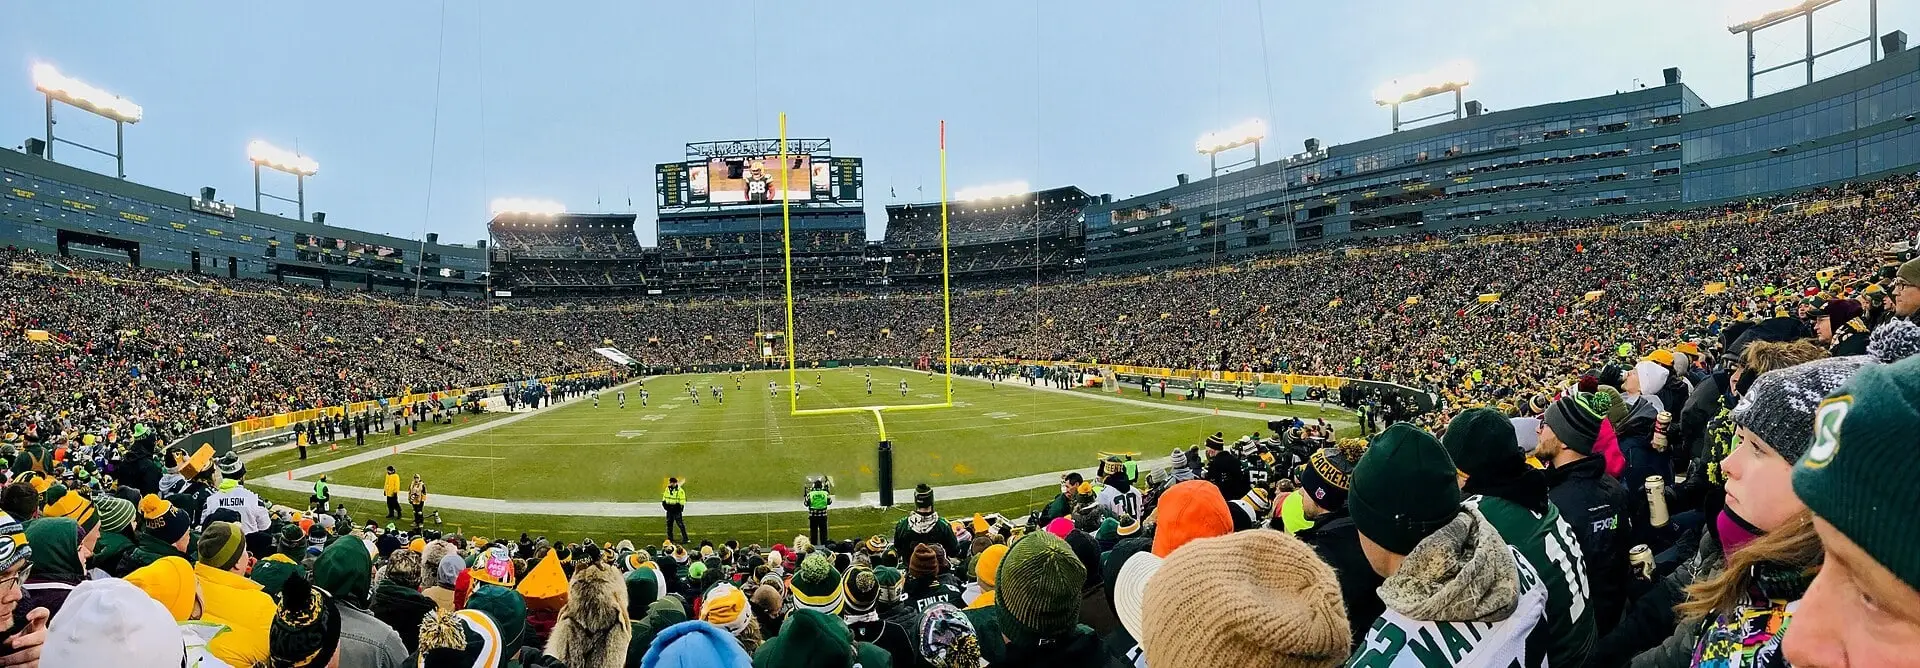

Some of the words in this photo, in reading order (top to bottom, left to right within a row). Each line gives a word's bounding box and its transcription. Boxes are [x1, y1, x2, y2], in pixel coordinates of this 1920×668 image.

[699, 142, 768, 155] LAMBEAU
[776, 141, 818, 152] FIELD
[749, 180, 766, 194] 88
[219, 497, 245, 507] WILSON
[917, 593, 949, 613] FINLEY
